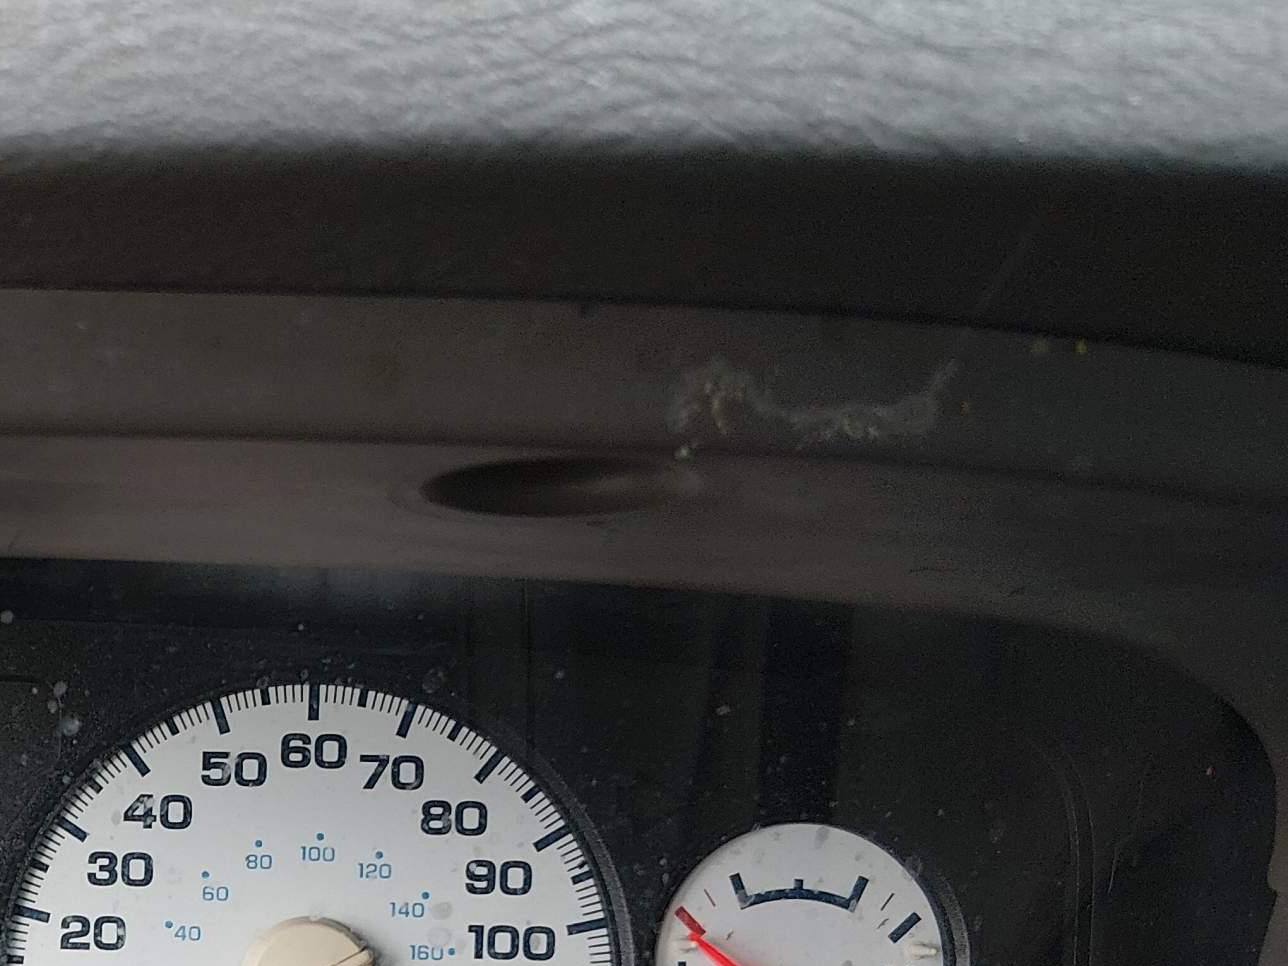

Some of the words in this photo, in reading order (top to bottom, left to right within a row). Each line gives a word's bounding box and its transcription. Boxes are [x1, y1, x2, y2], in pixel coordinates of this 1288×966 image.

[280, 733, 347, 769] 60
[201, 751, 267, 787] 50
[359, 755, 425, 790] 70
[123, 793, 192, 829] 40
[420, 800, 488, 836] 80
[87, 851, 153, 887] 30
[245, 854, 272, 870] 80
[300, 846, 335, 862] 100
[358, 863, 392, 879] 120
[202, 886, 229, 901] 60
[465, 859, 532, 895] 90
[390, 902, 425, 918] 140
[60, 915, 127, 951] 20
[174, 925, 201, 941] 40
[468, 925, 556, 961] 100
[409, 945, 444, 961] 160
